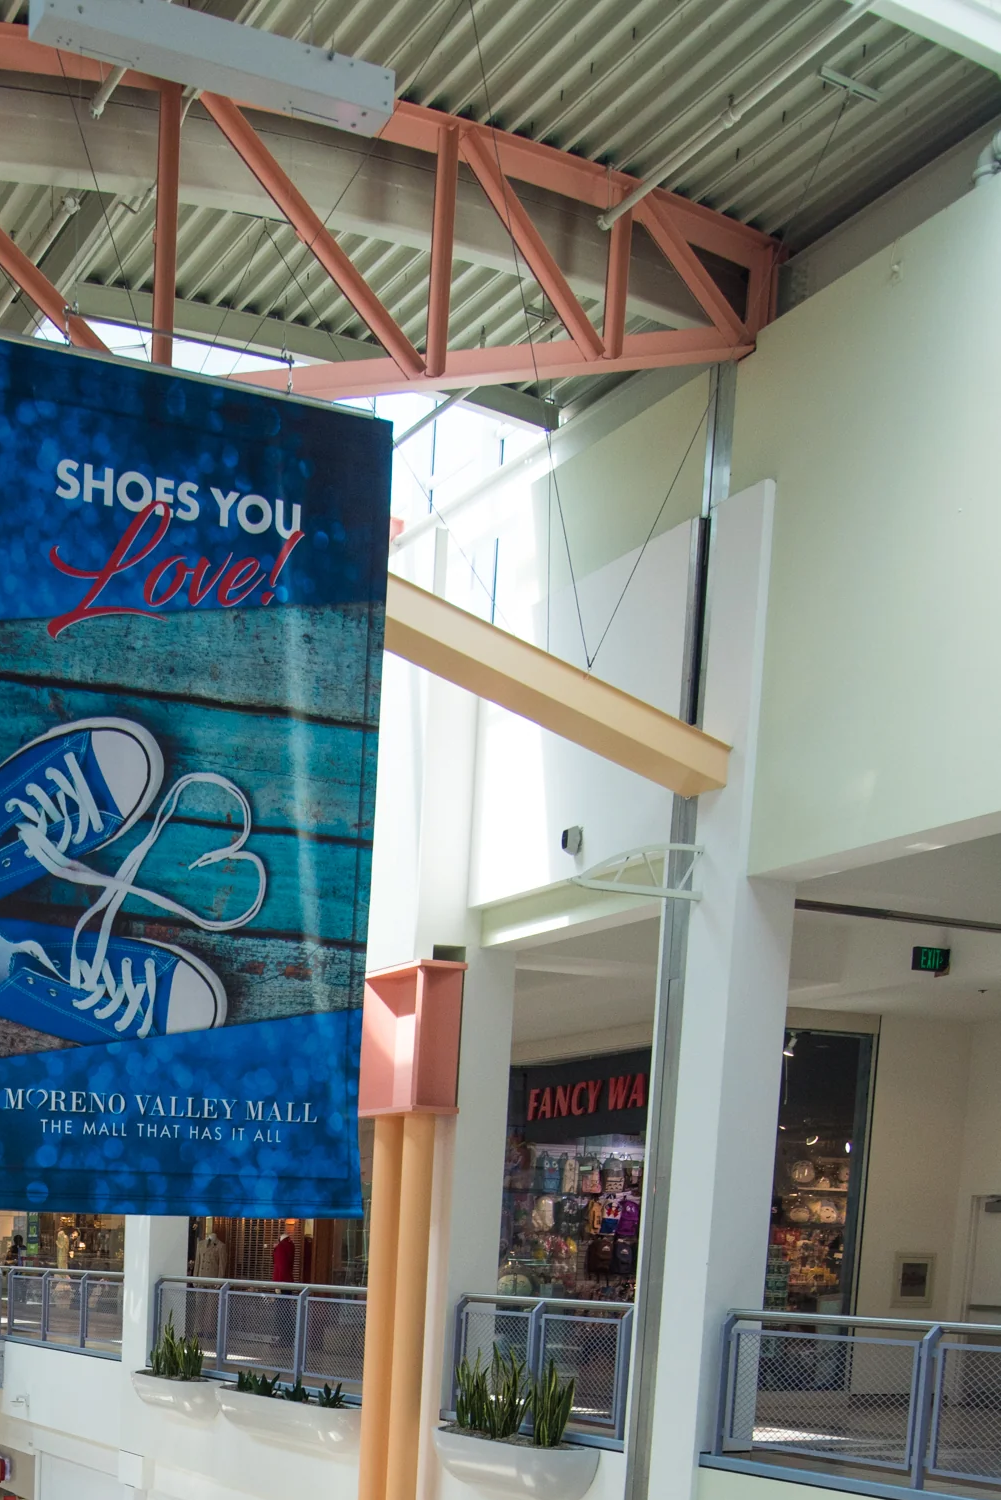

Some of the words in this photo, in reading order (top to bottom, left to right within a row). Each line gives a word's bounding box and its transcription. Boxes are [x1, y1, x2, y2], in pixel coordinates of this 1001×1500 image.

[55, 459, 199, 521] SHOES
[209, 487, 302, 540] YOU
[47, 501, 304, 641] Love!
[921, 948, 941, 969] EXIT
[135, 1094, 238, 1120] VALLEY
[245, 1101, 318, 1123] MALL
[527, 1080, 602, 1121] FANCY
[40, 1118, 72, 1135] THE
[83, 1121, 127, 1138] MALL
[137, 1123, 180, 1139] THAT
[189, 1125, 222, 1141] HAS
[231, 1127, 246, 1142] IT
[253, 1128, 282, 1143] ALL
